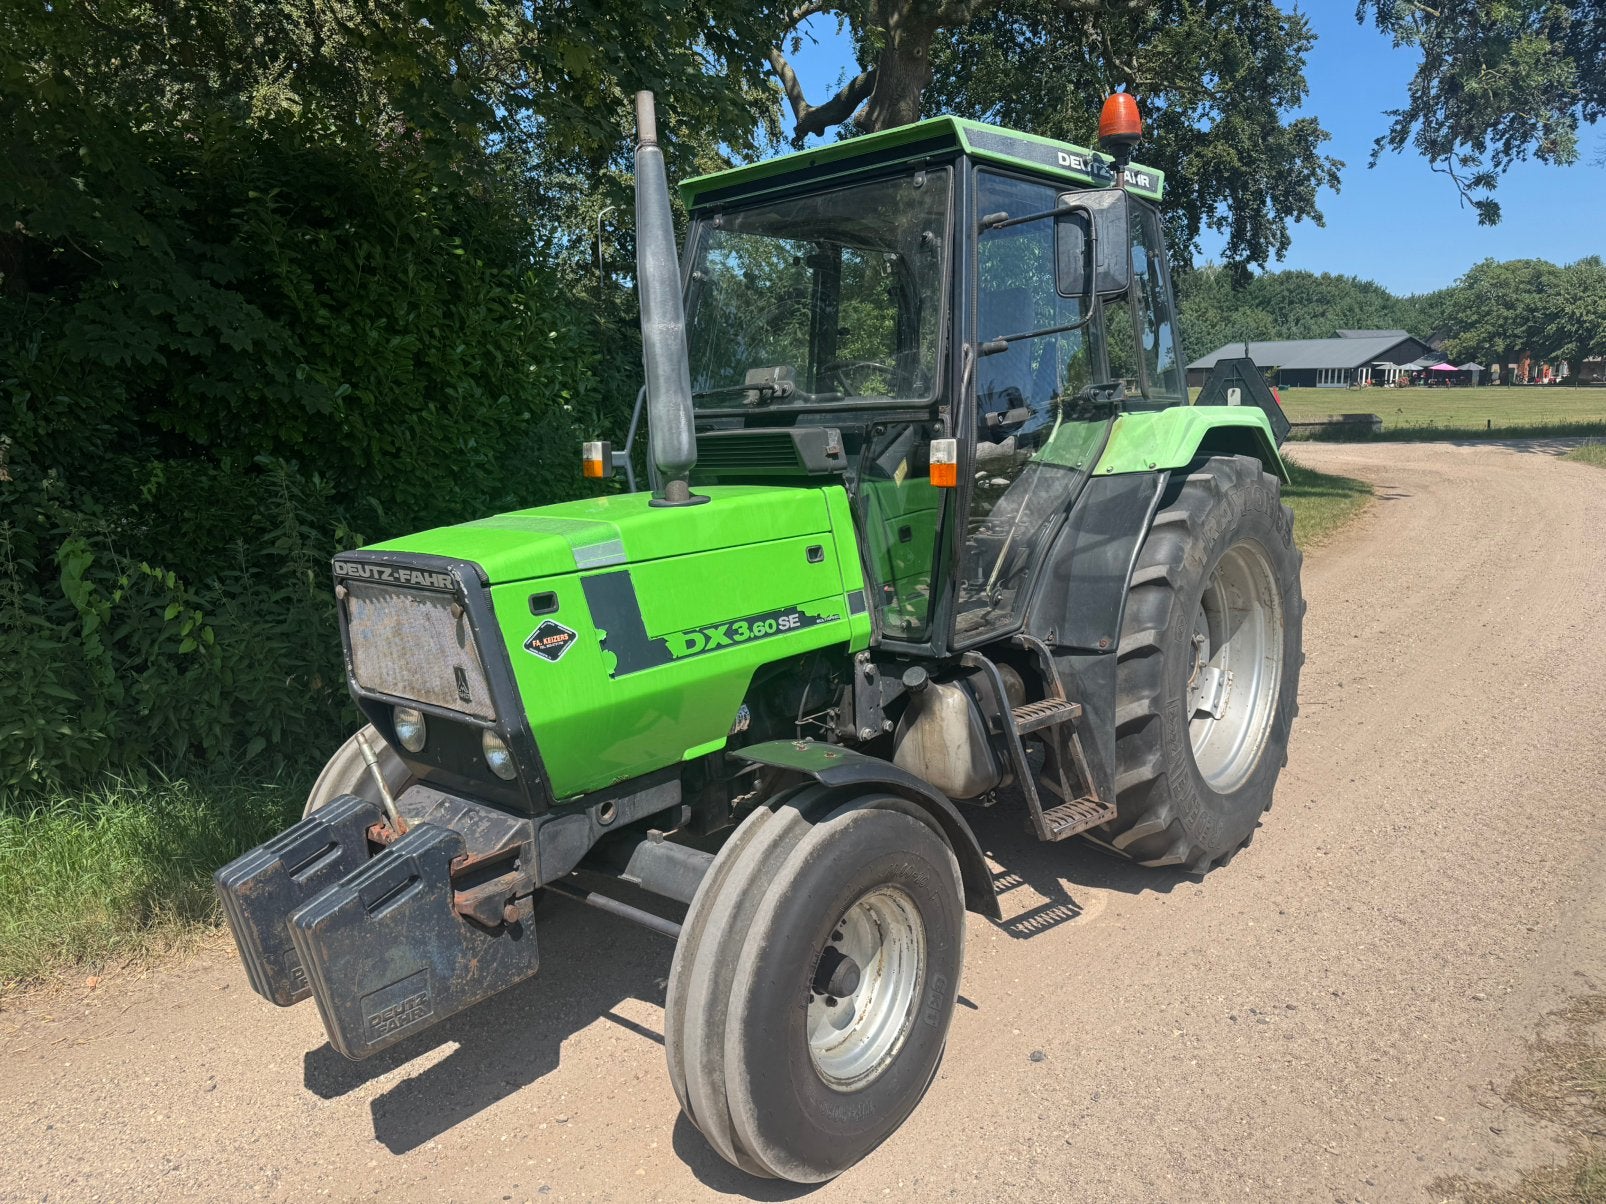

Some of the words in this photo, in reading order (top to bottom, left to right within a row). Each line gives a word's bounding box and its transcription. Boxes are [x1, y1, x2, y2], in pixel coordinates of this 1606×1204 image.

[334, 561, 454, 590] DEUTZ-FAHR
[778, 613, 800, 631] SE
[543, 633, 569, 645] KEIZERS
